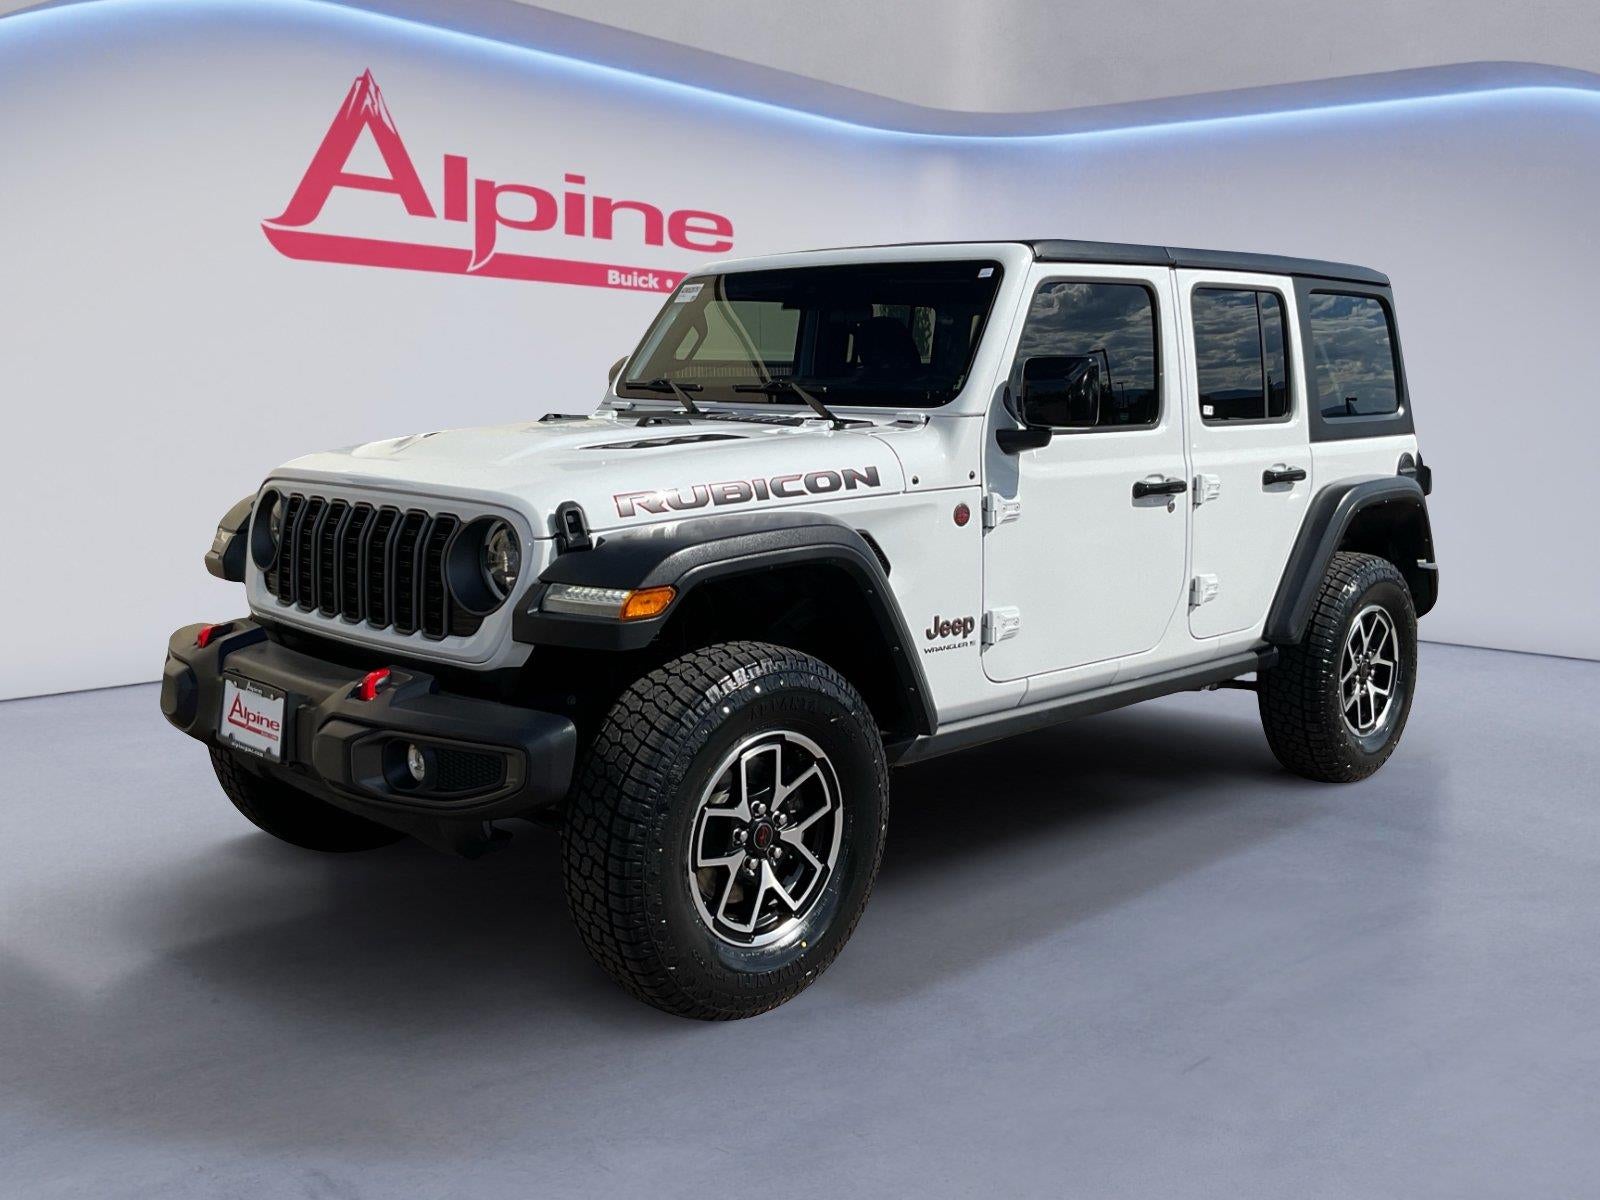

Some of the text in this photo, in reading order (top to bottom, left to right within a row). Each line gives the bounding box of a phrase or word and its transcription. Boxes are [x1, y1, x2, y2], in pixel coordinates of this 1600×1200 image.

[261, 67, 733, 272] Alpine
[606, 270, 660, 290] Buick
[613, 466, 881, 518] RUBICON
[925, 614, 976, 641] Jeep
[923, 641, 969, 654] WRANGLER
[228, 692, 280, 729] Alpine
